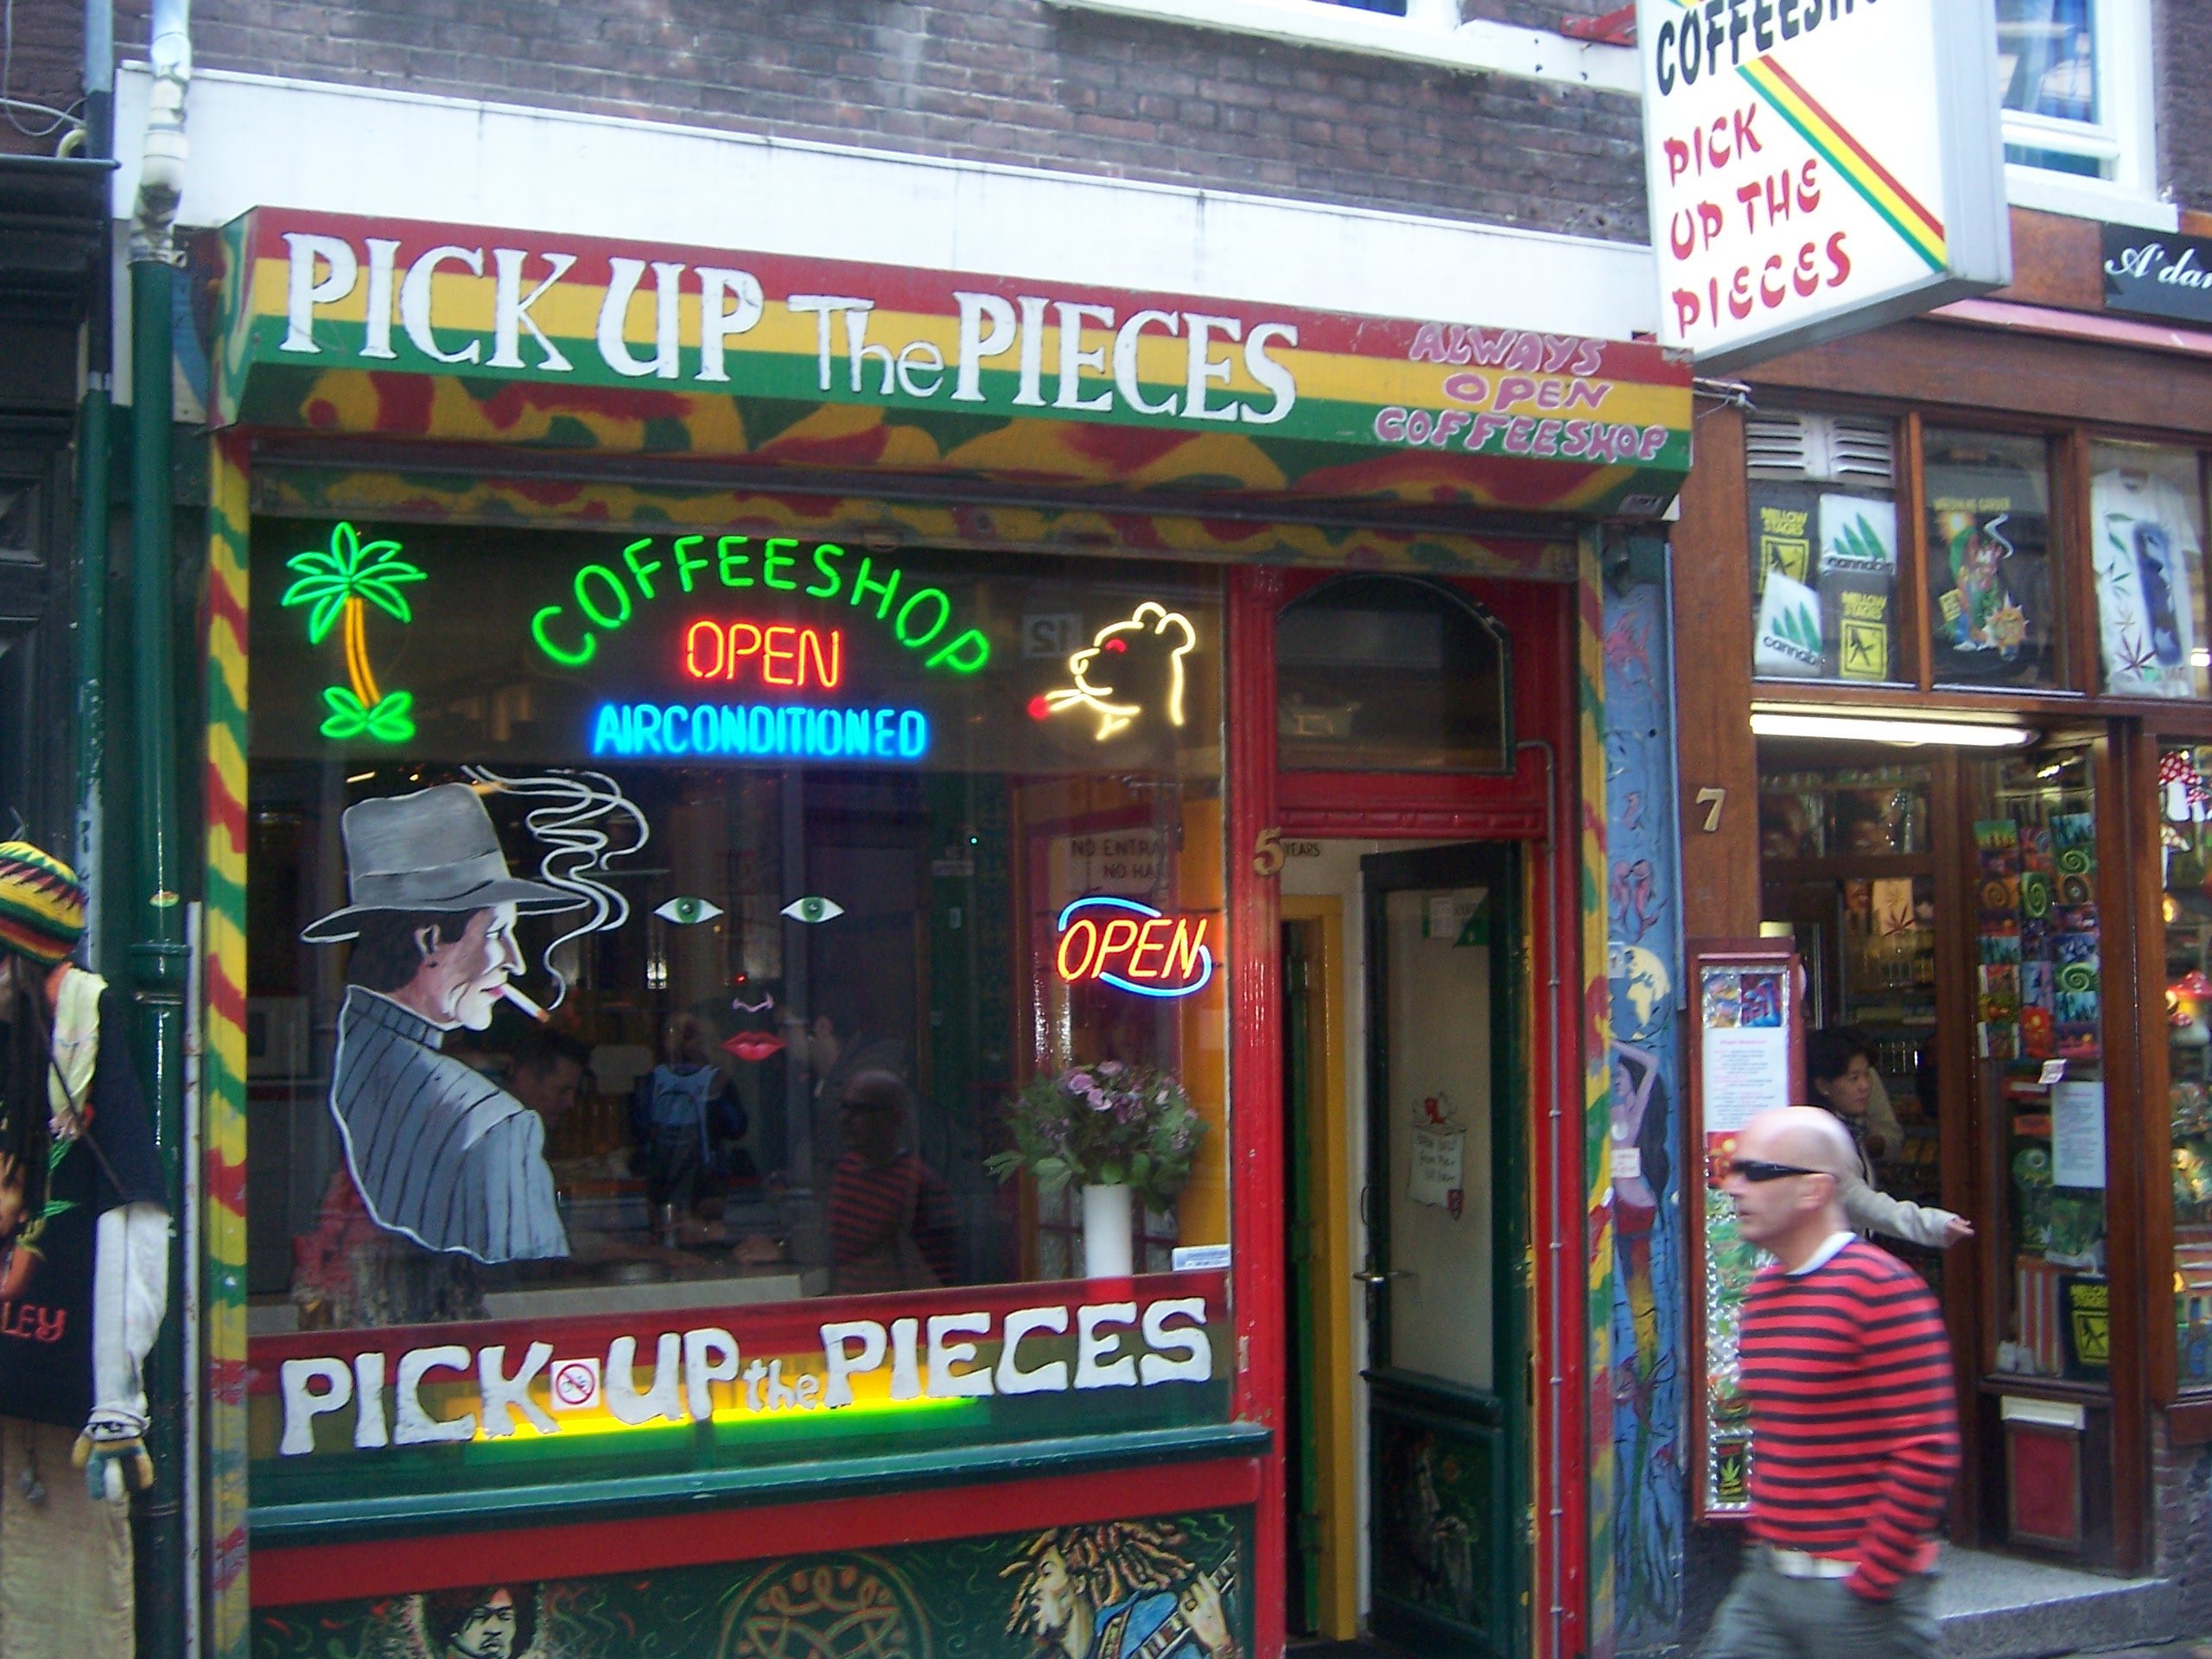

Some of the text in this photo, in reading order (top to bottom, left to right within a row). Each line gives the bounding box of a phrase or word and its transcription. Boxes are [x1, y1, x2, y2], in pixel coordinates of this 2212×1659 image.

[1656, 0, 1877, 96] COFFEE
[1662, 102, 1762, 188] PICK
[1670, 158, 1821, 261] UP THE
[1672, 230, 1852, 339] PIECES
[279, 232, 1300, 424] PICK UP The PIECES
[1409, 323, 1607, 376] ALWAYS
[1442, 372, 1612, 413] OPEN
[1374, 406, 1669, 463] COFFEESHOP
[531, 535, 990, 673] COFFEESHOP
[687, 620, 842, 688] OPEN
[593, 702, 928, 757] AIRCONDITIONED
[1695, 787, 1726, 832] 7
[1254, 825, 1285, 876] 5
[1057, 917, 1208, 982] OPEN
[280, 1297, 1212, 1456] PICK UP the PIECES
